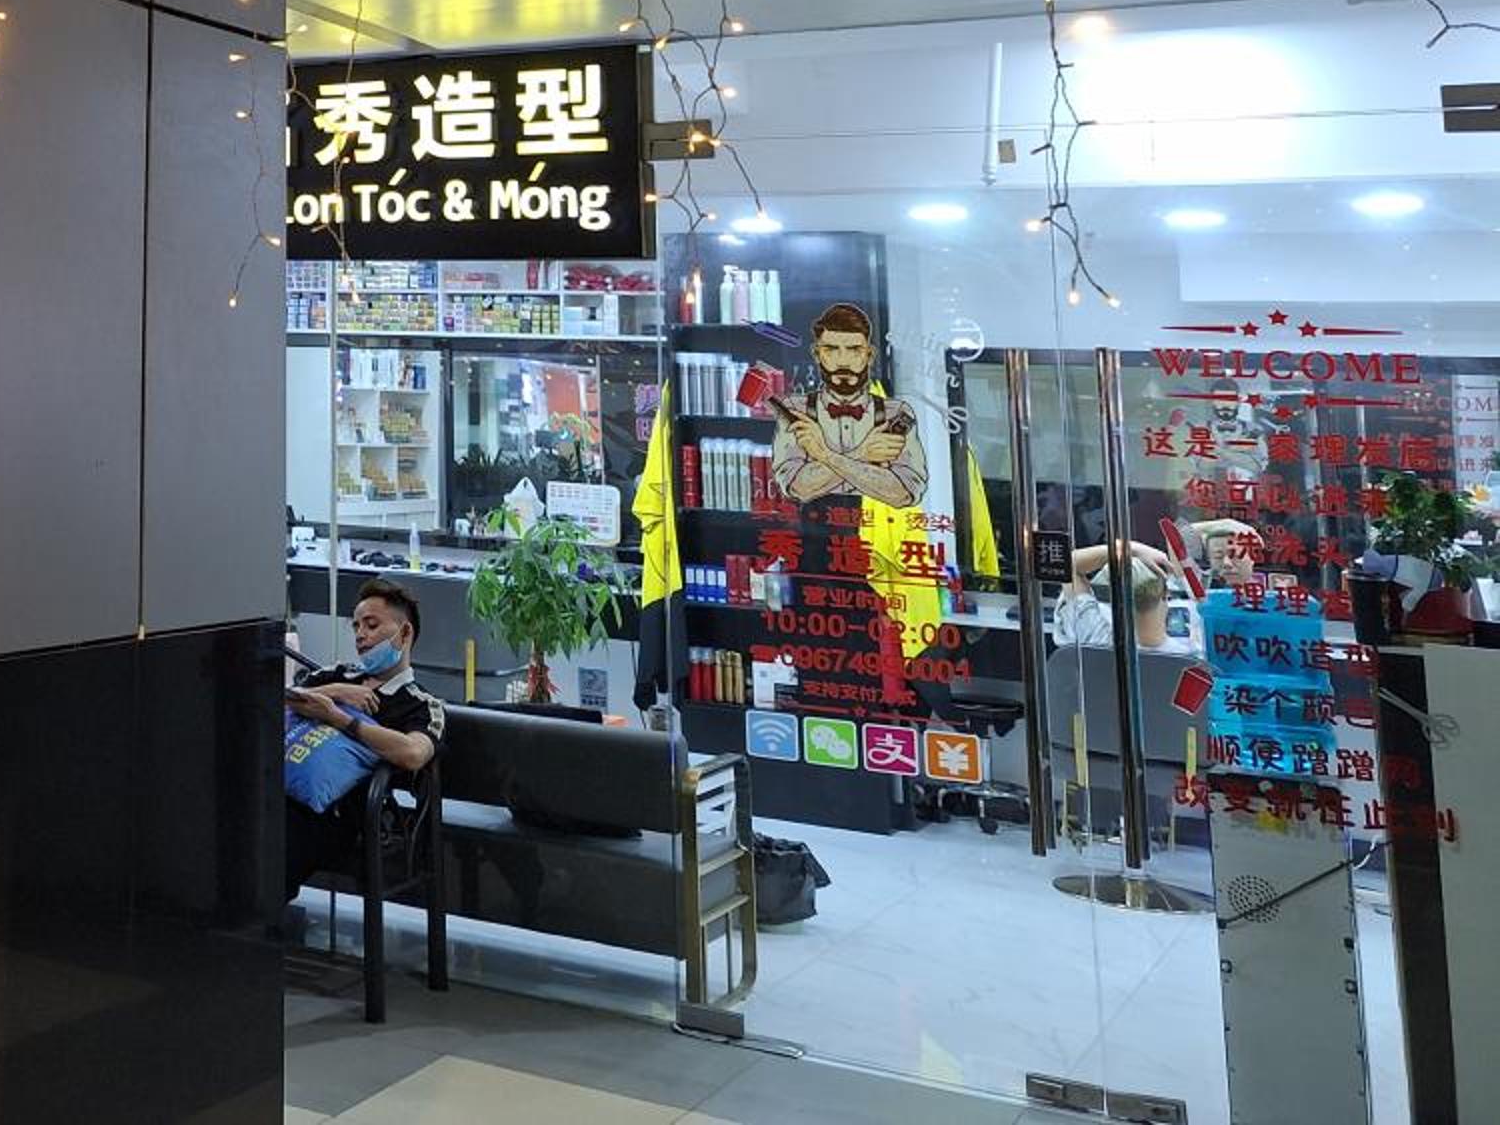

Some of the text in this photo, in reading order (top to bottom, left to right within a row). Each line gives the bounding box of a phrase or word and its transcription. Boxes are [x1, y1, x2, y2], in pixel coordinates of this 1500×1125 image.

[286, 64, 609, 167] 秀造型
[353, 168, 431, 224] Tóc
[443, 179, 475, 222] &
[489, 161, 611, 231] Móng
[1151, 347, 1422, 384] WELCOME
[1143, 426, 1438, 471] 这是一家理发店
[754, 527, 948, 581] 秀造型
[1036, 539, 1065, 564] 推
[1227, 530, 1350, 567] 洗洗头
[802, 585, 907, 612] 营业时间
[1213, 632, 1380, 677] 吹吹造型
[1224, 684, 1379, 731] 染个颜色
